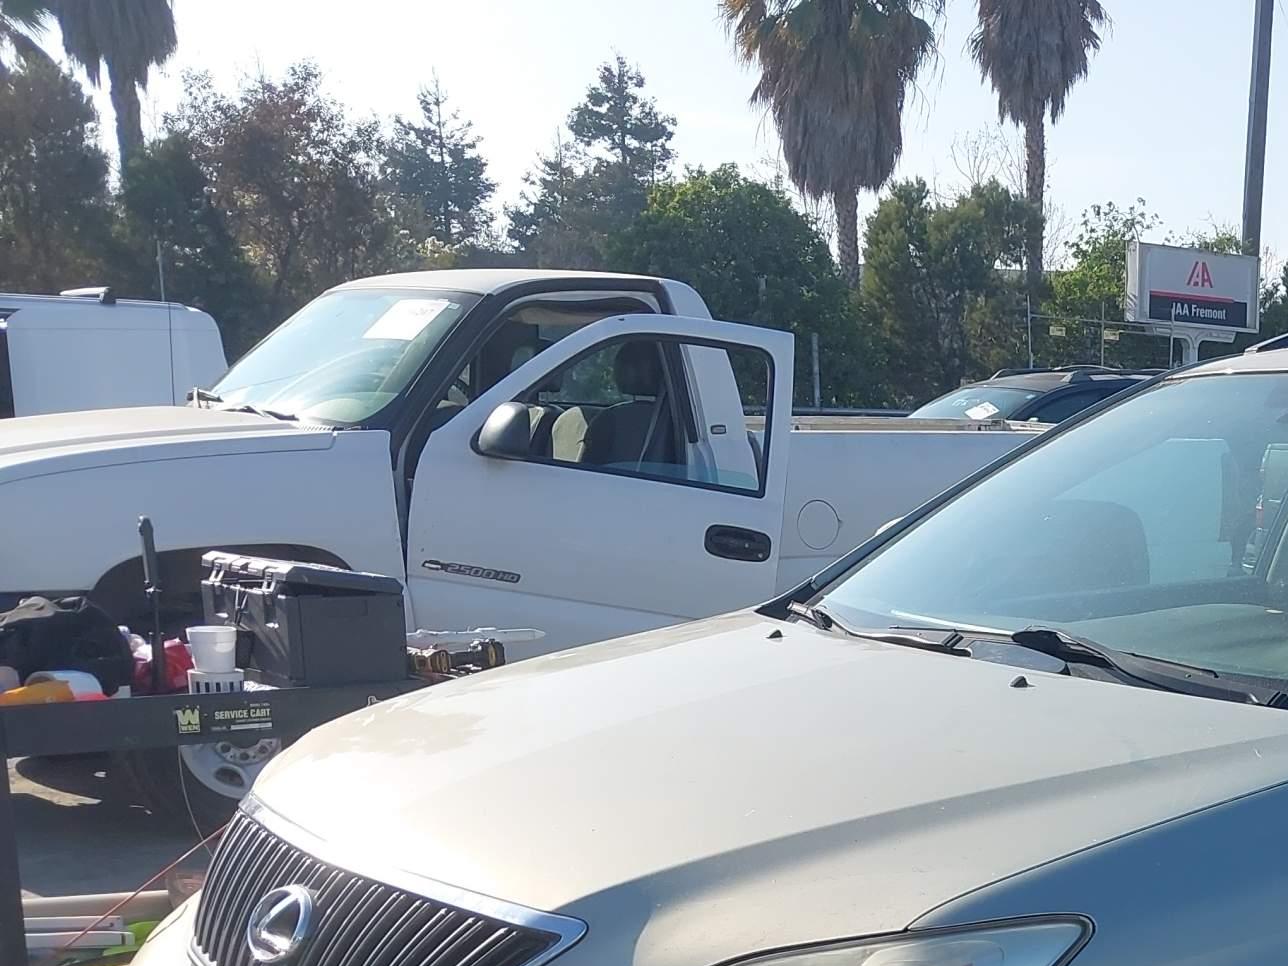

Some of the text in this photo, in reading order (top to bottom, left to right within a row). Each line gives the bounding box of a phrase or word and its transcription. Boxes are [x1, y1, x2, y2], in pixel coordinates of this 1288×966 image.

[1173, 302, 1227, 320] IAA Fremont
[214, 708, 271, 720] SERVICE CART
